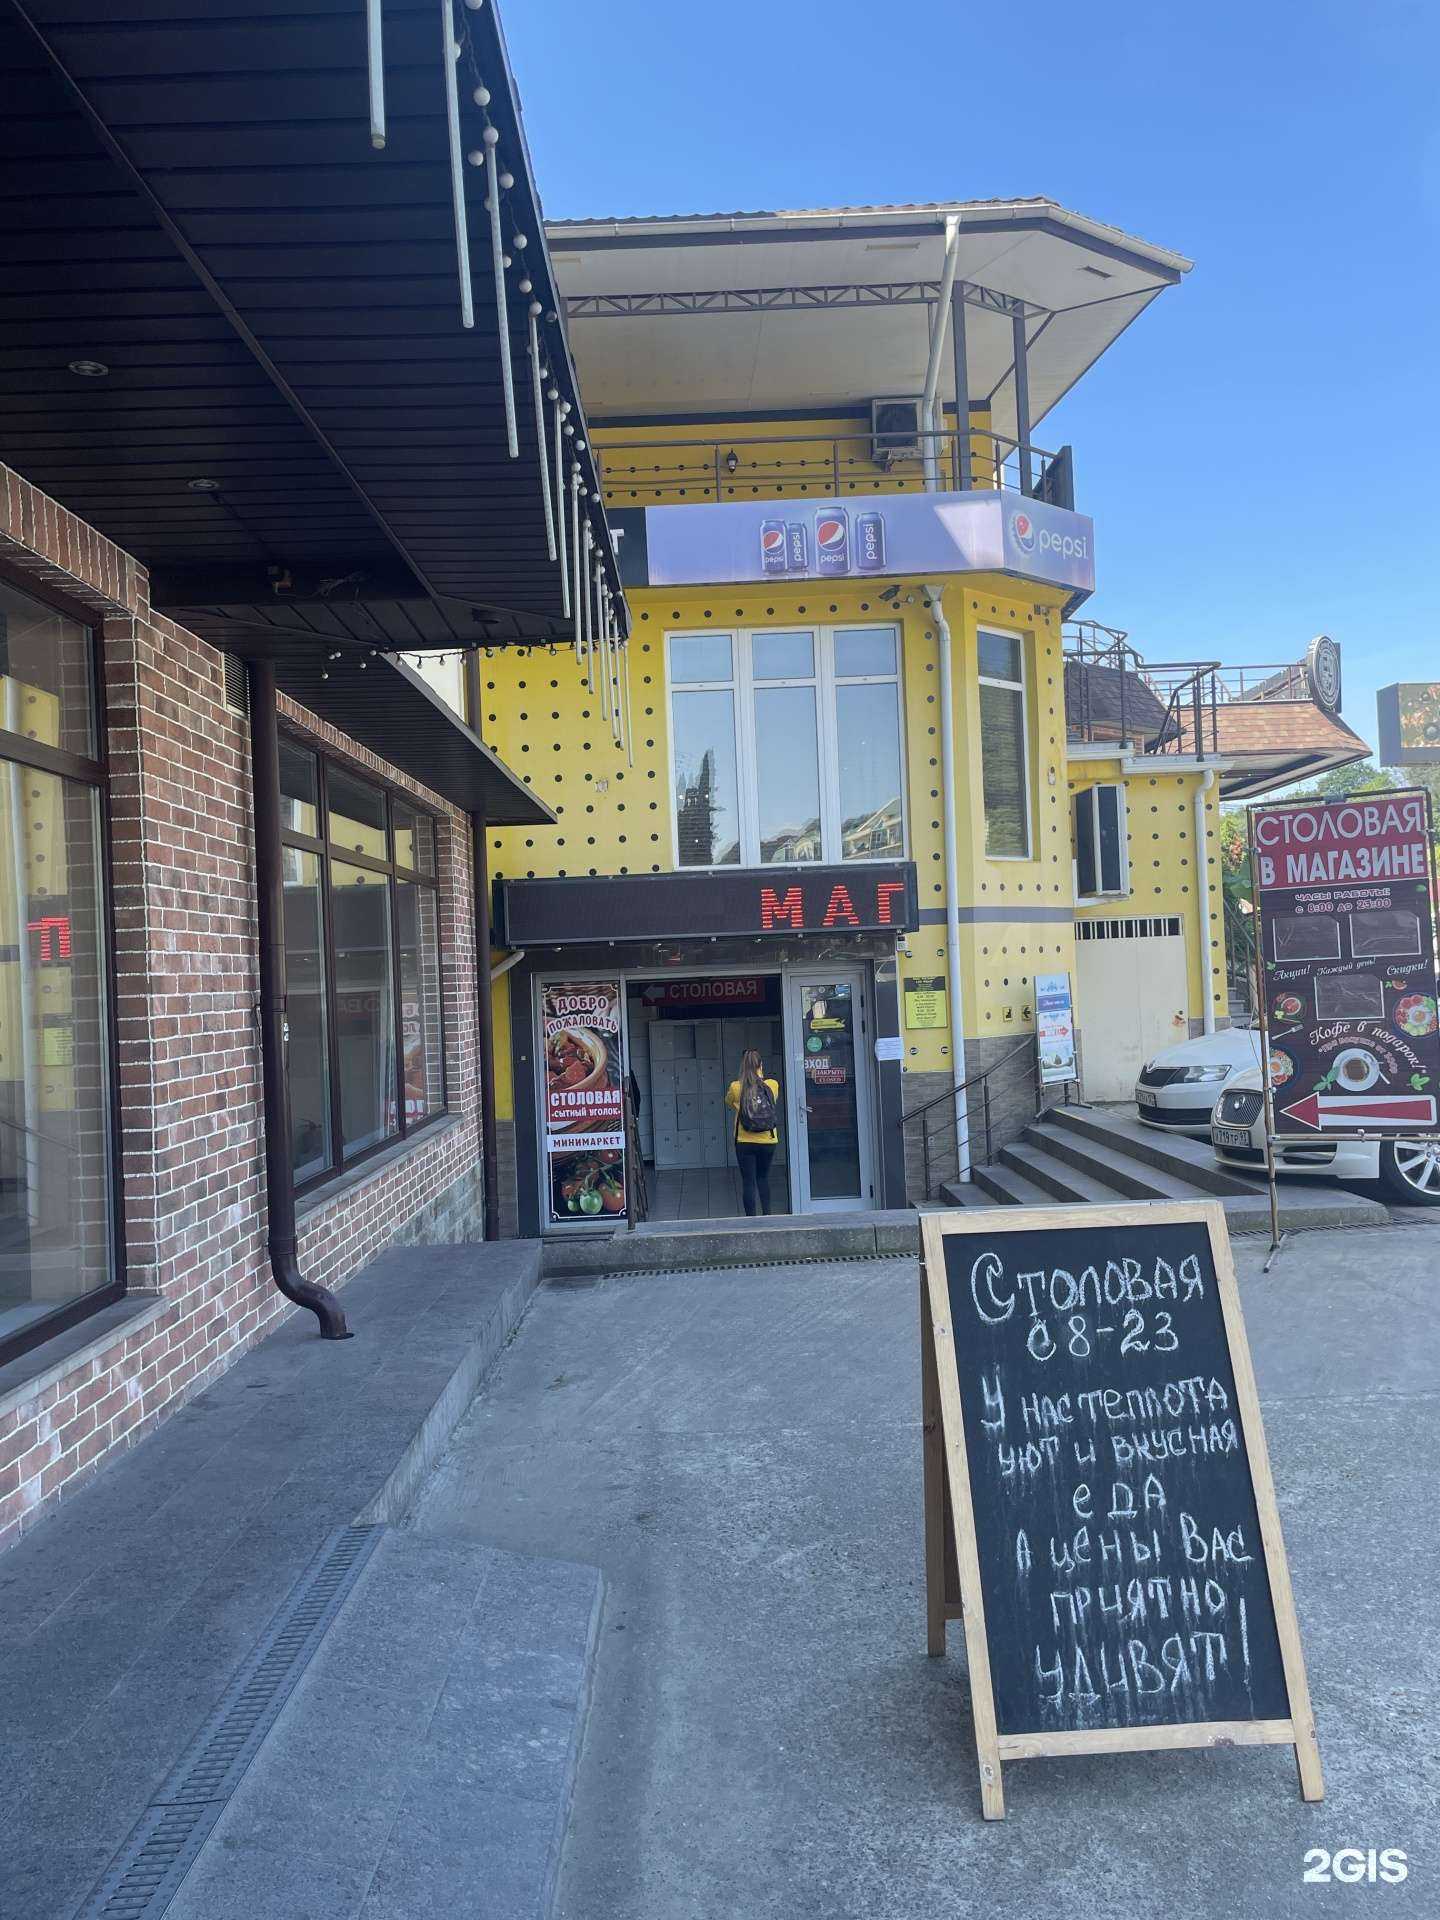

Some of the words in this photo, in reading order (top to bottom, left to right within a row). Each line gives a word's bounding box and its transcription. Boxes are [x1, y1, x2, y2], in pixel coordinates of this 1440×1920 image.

[792, 532, 803, 562] pepsi
[864, 523, 879, 560] pepsi
[1039, 529, 1089, 560] pepsi
[764, 555, 784, 564] pepsi
[820, 553, 845, 563] pepsi
[1256, 802, 1422, 846] СТОЛОВАЯ
[1260, 856, 1276, 886] В
[1286, 843, 1425, 884] МАГАЗИНЕ
[761, 883, 904, 928] МАГ
[1295, 891, 1331, 901] ЧАСЫ
[1272, 964, 1311, 981] Акции!
[1386, 959, 1429, 976] Скидки!
[670, 980, 757, 999] СТОЛОВАЯ
[557, 996, 608, 1014] ДОБРО
[548, 1015, 618, 1035] ПОЖАЛОВАТЬ
[1309, 1021, 1350, 1045] Кофе
[1357, 1020, 1368, 1033] в
[551, 1089, 621, 1107] СТОЛОВАЯ
[553, 1137, 621, 1148] МИНИМАРКЕТ
[1068, 1309, 1180, 1358] 8-23
